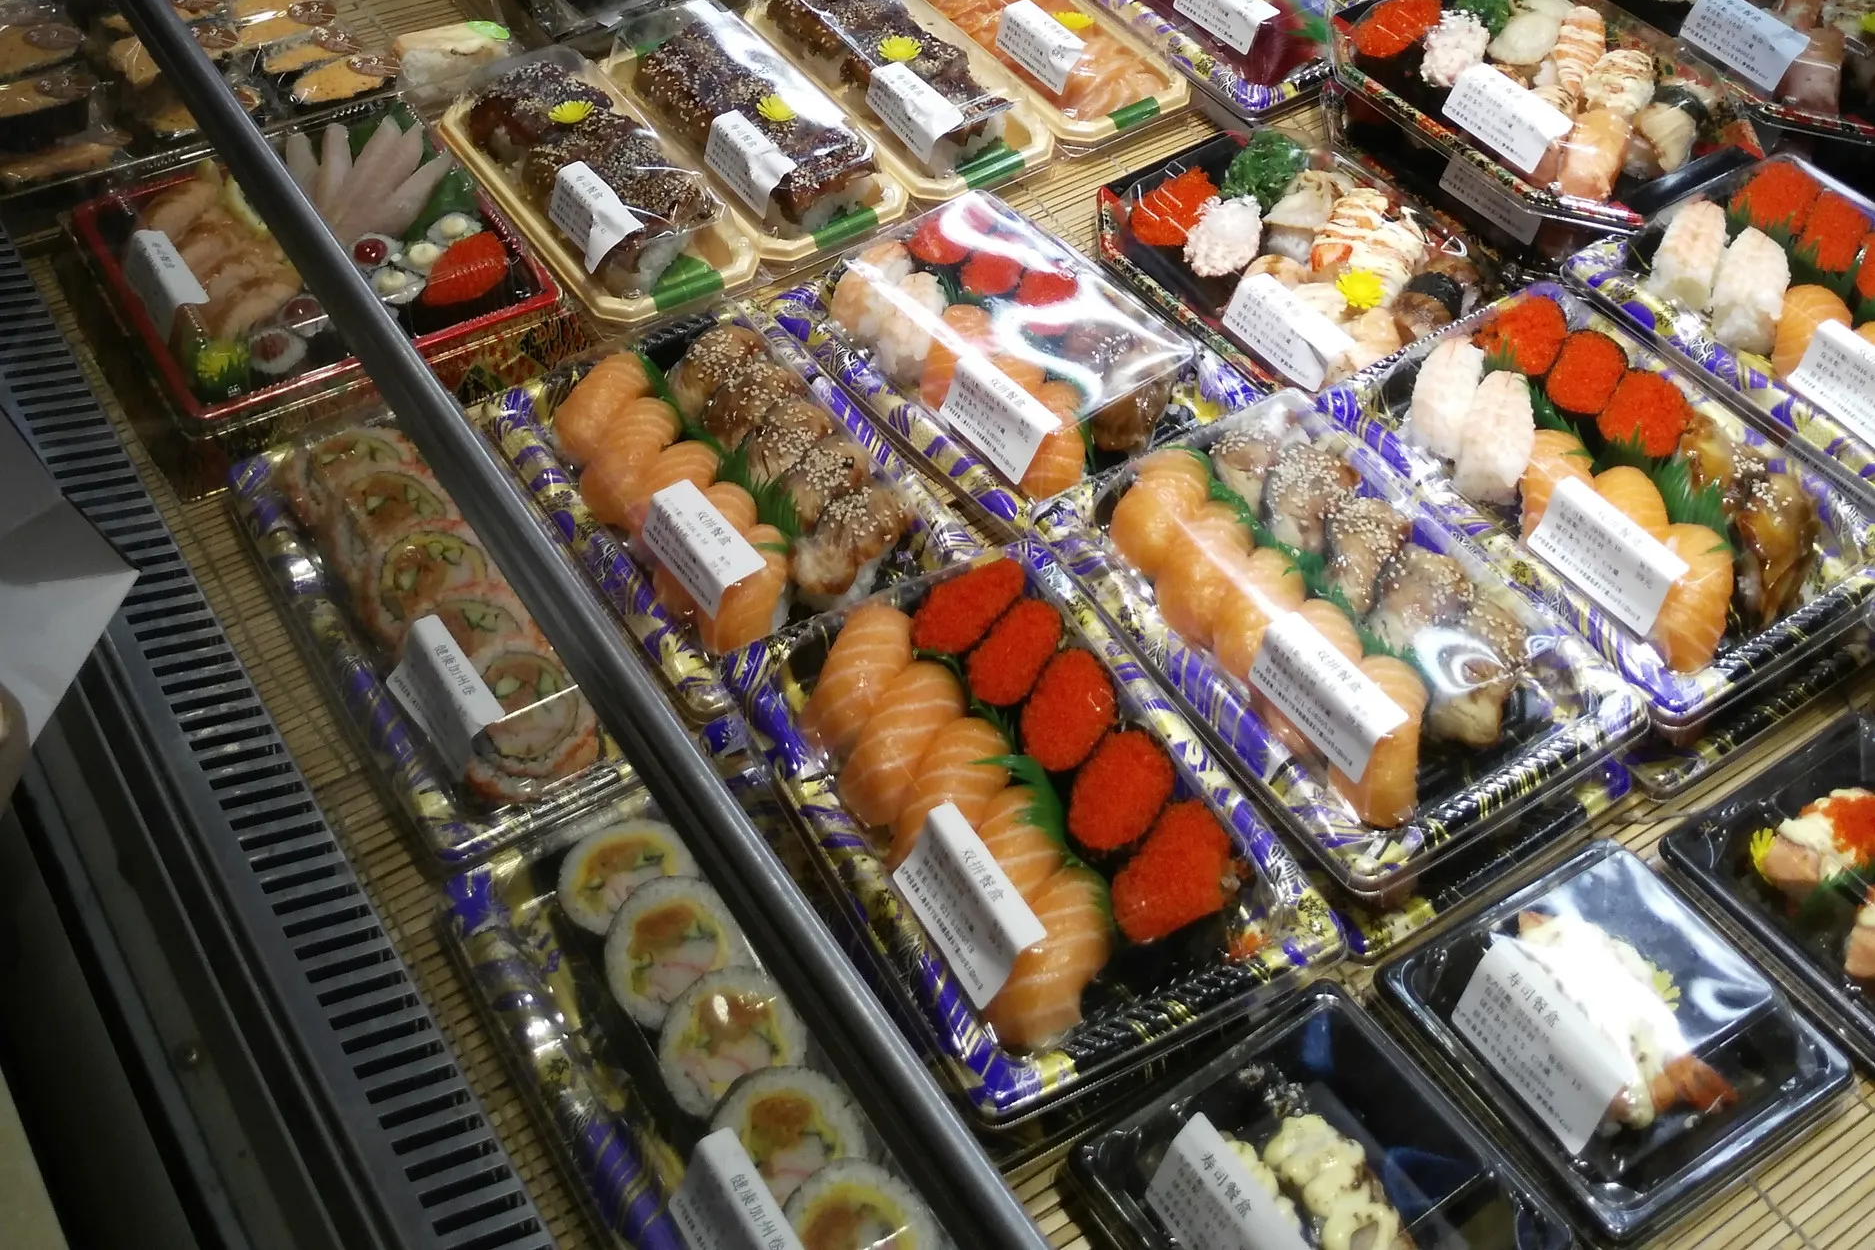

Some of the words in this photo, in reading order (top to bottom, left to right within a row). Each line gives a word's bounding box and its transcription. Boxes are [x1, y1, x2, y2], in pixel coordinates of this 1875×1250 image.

[693, 509, 734, 546] 双拼餐盒
[432, 642, 477, 697] 健康加州卷
[1314, 649, 1365, 693] 双拼餐盒
[958, 846, 1007, 903] 双拼餐盒
[1504, 968, 1560, 1028] 寿司餐盒
[1194, 1149, 1256, 1218] 寿司餐盒
